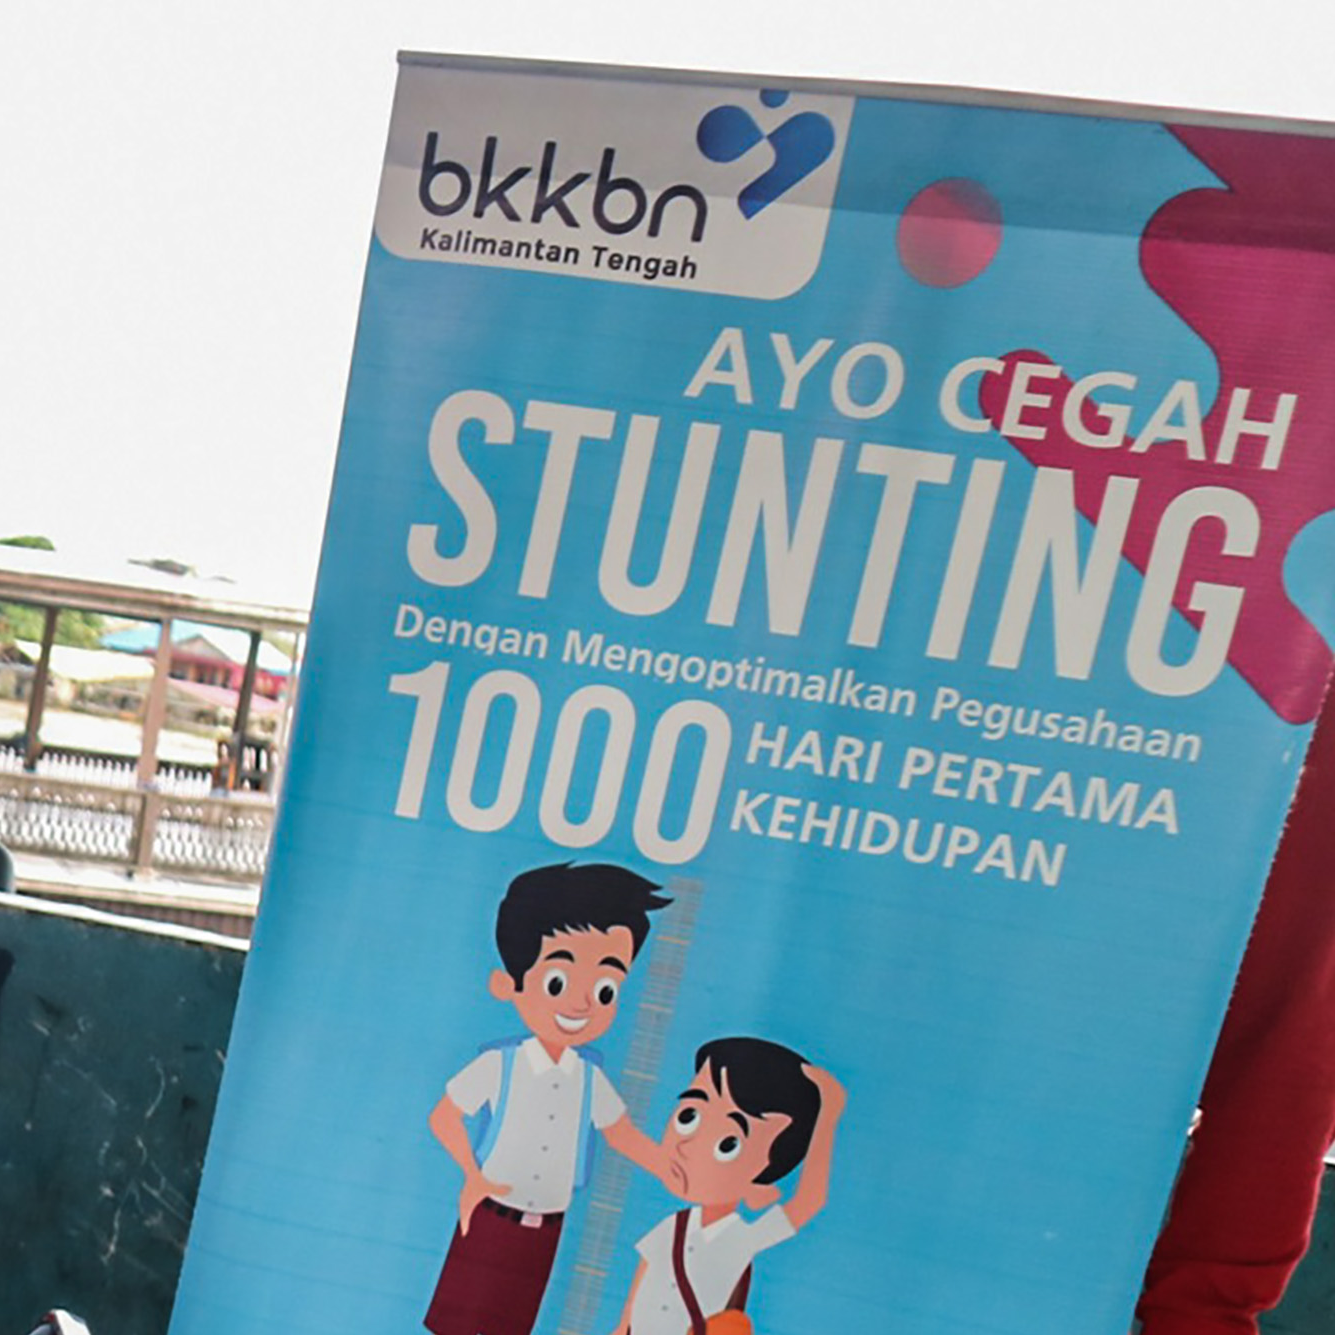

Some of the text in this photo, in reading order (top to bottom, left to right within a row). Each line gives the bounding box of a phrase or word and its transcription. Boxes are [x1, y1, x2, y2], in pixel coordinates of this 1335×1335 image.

[417, 131, 709, 242] bkkbn
[420, 227, 696, 280] Kalimantan Tengah
[682, 326, 1297, 470] AYO CEGAH
[405, 388, 1261, 697] STUNTING
[393, 603, 1203, 764] Dengan Mengoptimalkan Pegusahaan
[388, 659, 733, 865] 1000
[744, 721, 1179, 834] HARI PERTAMA
[729, 788, 1067, 887] KEHIDUPAN
